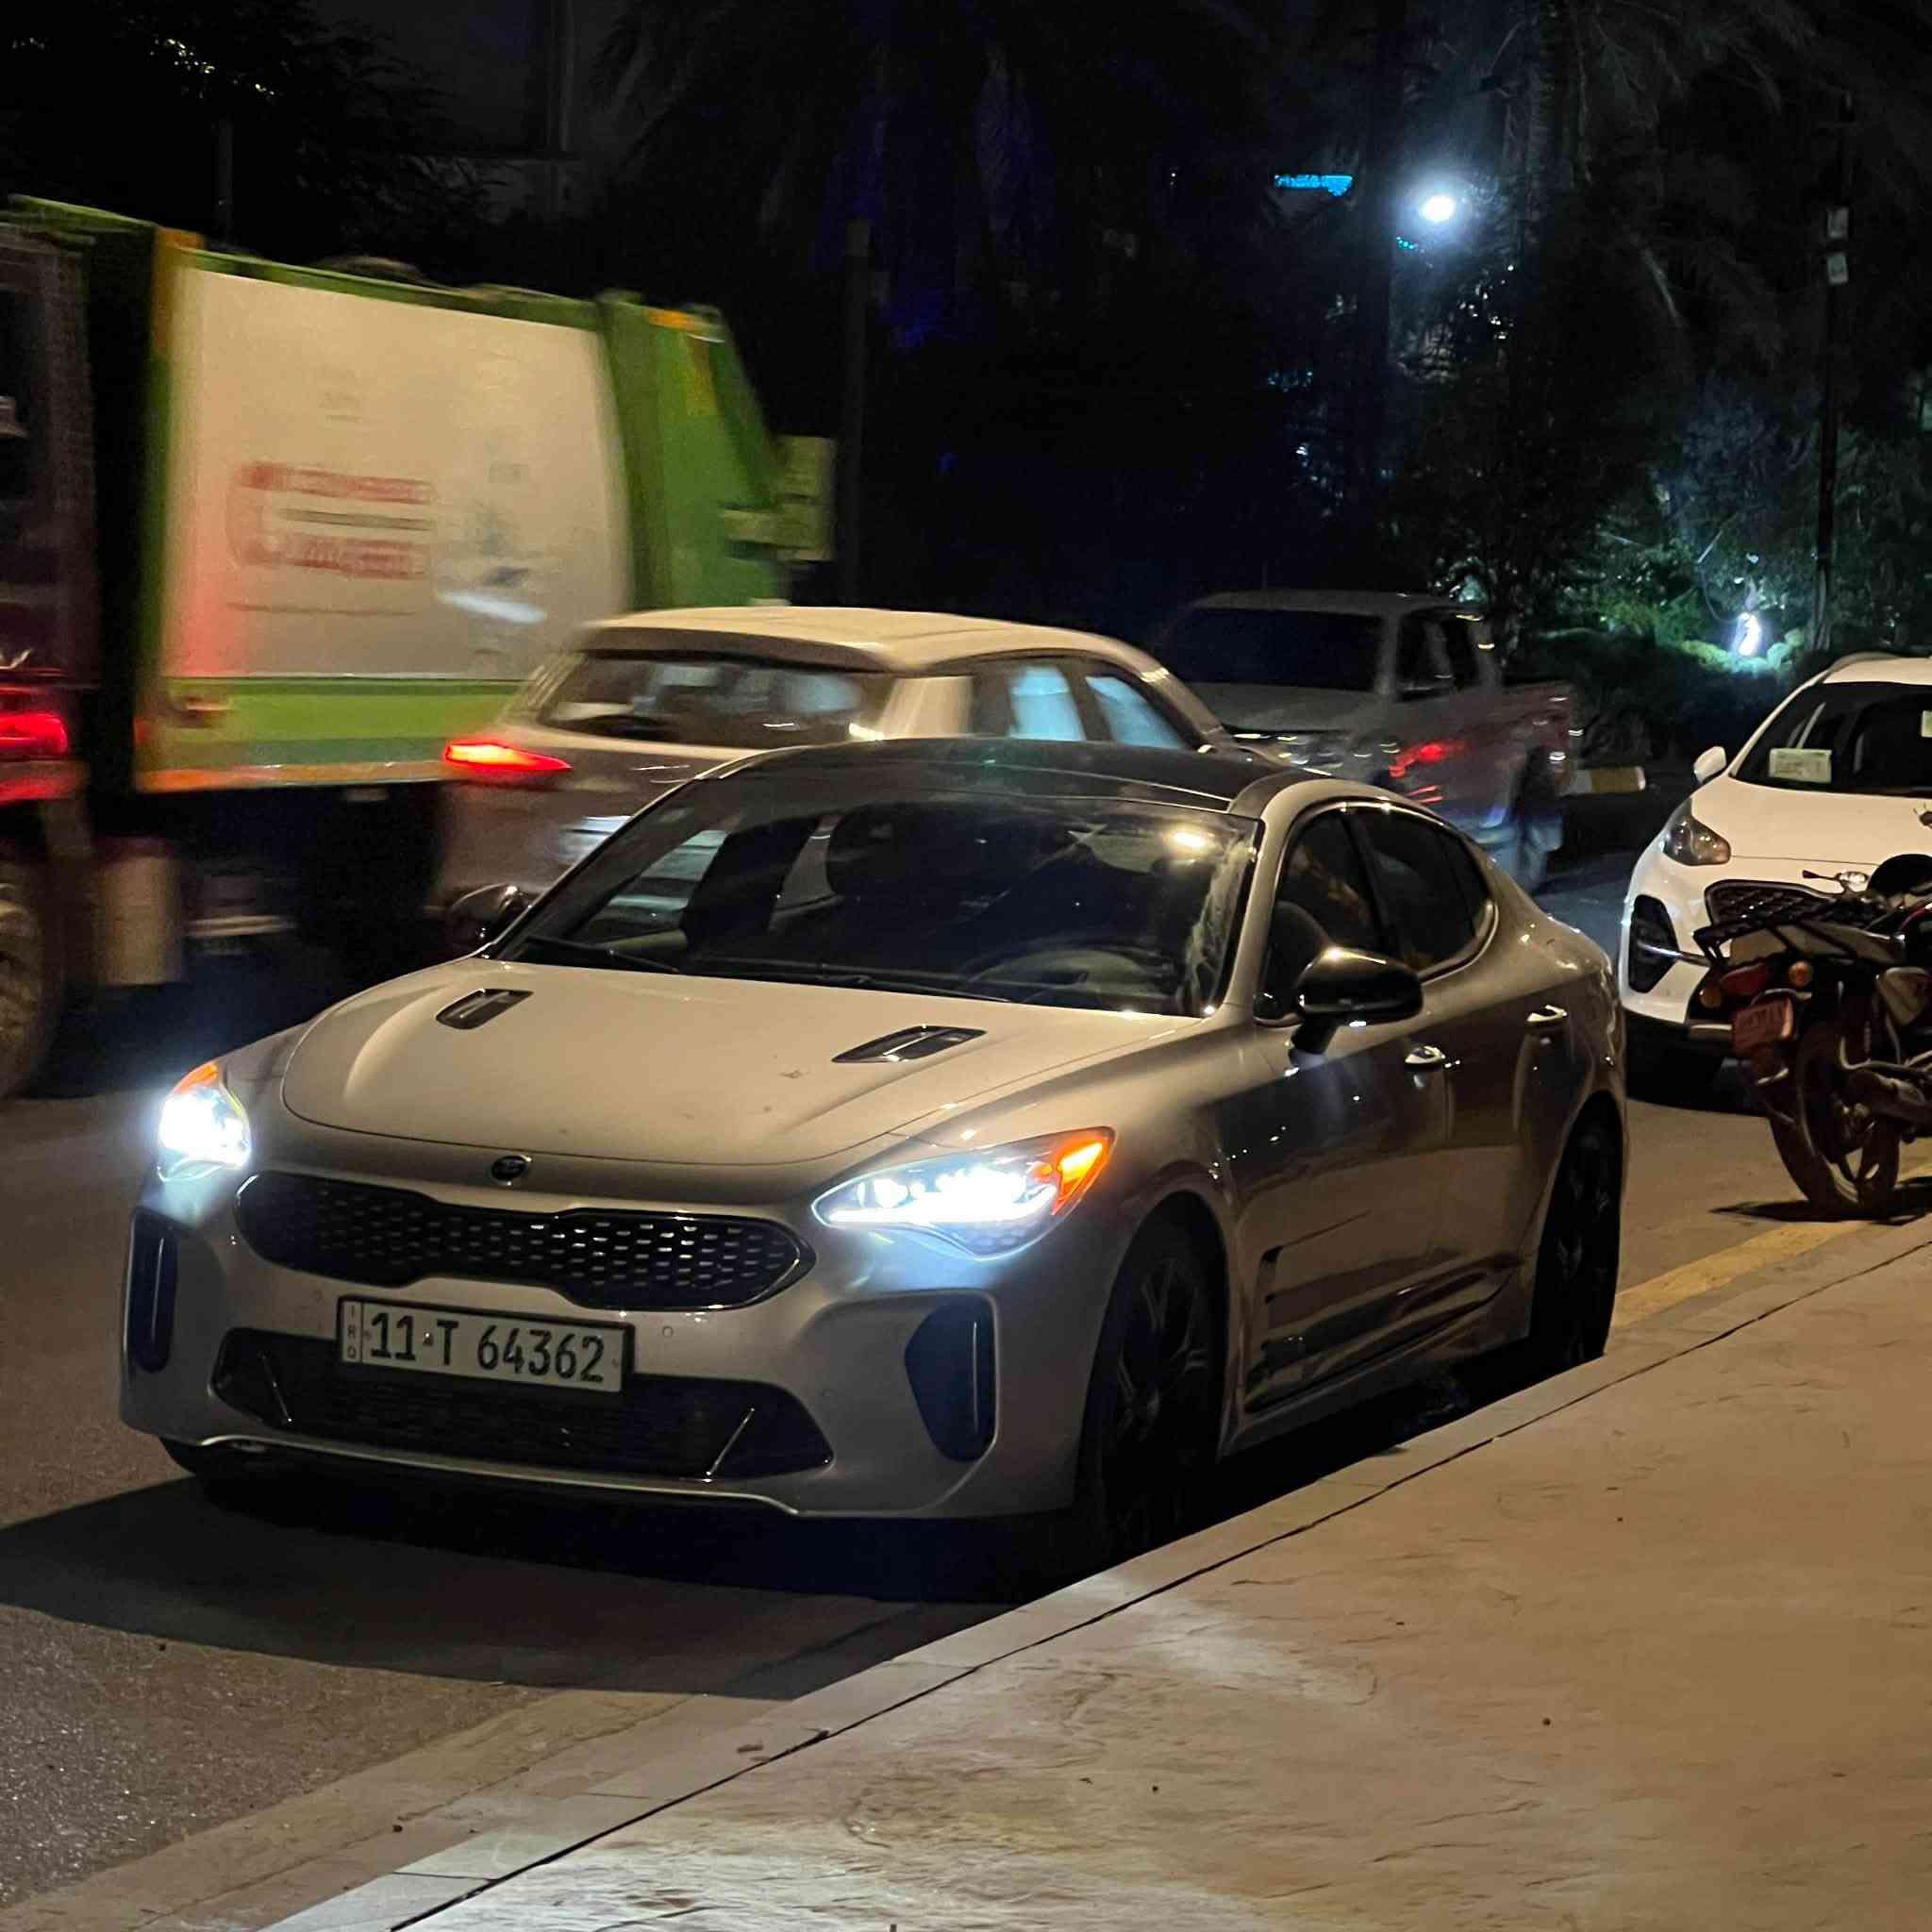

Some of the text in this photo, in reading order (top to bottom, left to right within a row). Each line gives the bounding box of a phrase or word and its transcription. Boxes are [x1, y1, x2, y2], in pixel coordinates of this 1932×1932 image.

[371, 1312, 606, 1383] 11 T 64362
